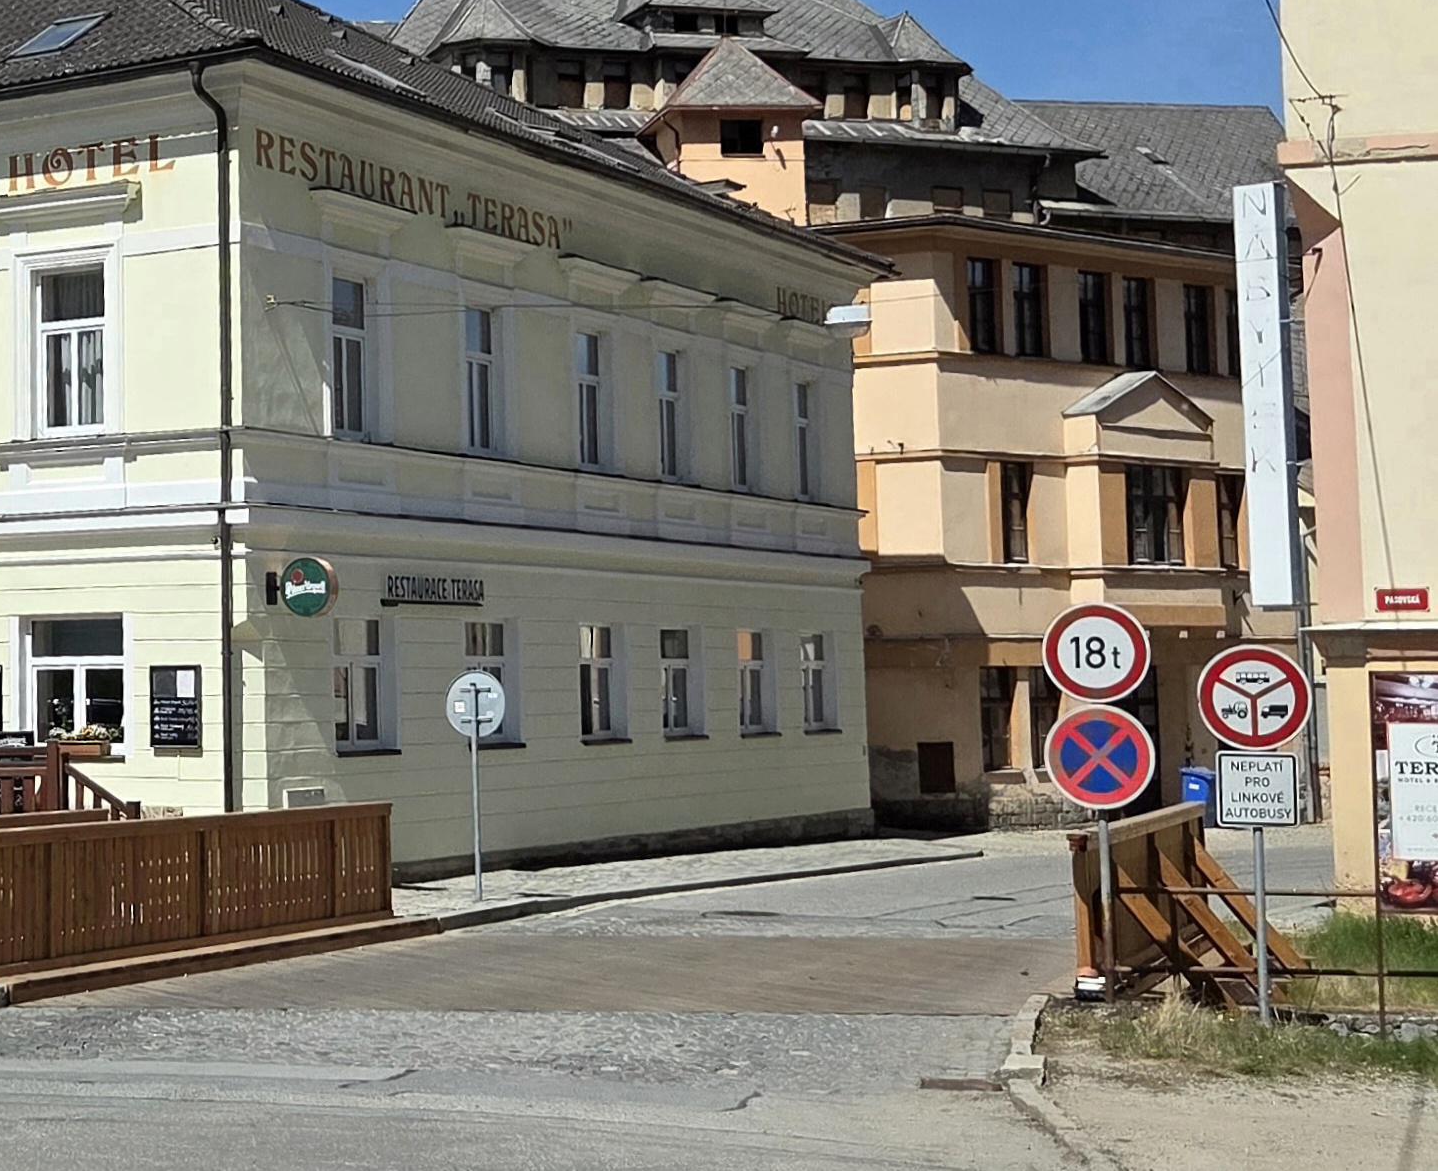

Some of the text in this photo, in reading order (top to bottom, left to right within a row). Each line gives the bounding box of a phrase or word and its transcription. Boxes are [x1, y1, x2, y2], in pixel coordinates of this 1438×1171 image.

[8, 133, 177, 192] HOTEL
[255, 128, 451, 220] RESTAURANT
[387, 574, 485, 601] RESTAURACE TERASA
[1070, 636, 1106, 669] 18
[1230, 759, 1284, 772] NEPLATÍ
[1394, 760, 1438, 775] TER
[1245, 776, 1271, 788] PRO
[1231, 791, 1284, 803] LINKOVÉ
[1225, 807, 1292, 819] AUTOBUSY
